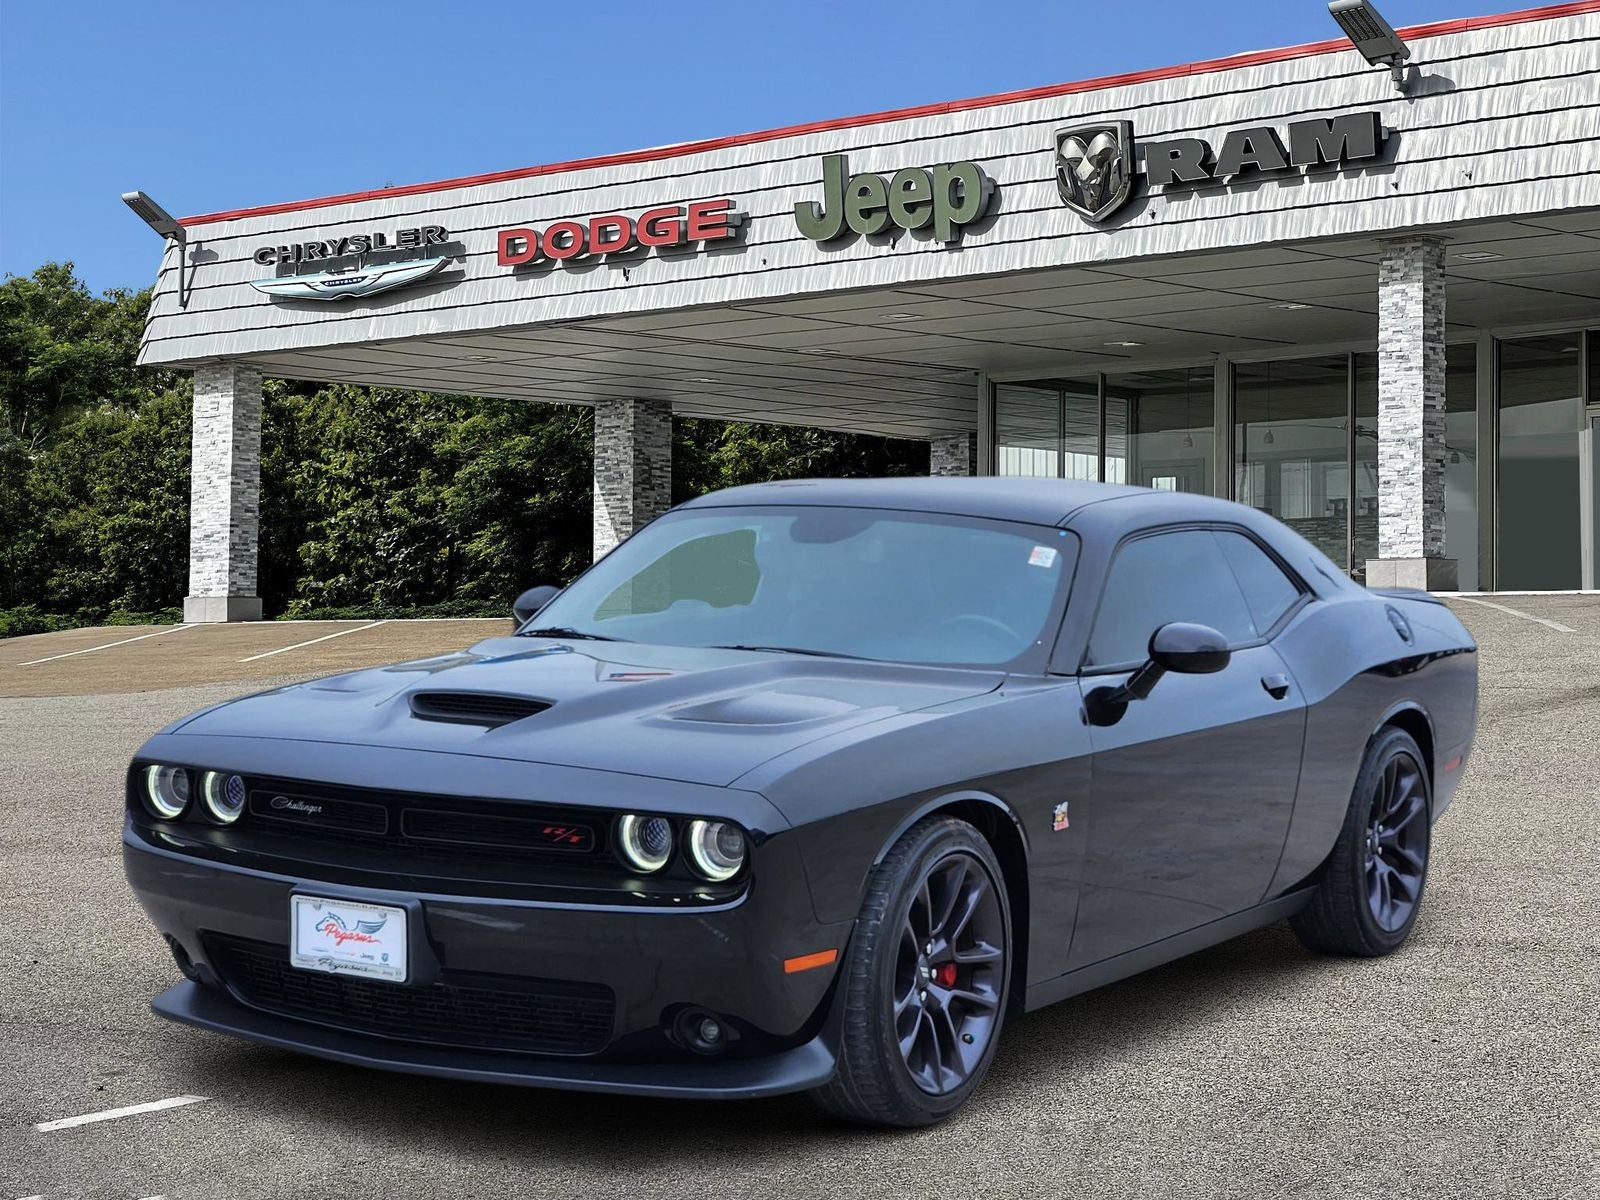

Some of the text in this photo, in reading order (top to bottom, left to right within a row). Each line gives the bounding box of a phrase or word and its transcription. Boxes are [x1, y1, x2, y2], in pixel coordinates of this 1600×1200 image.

[1144, 111, 1381, 186] RAM
[794, 154, 988, 242] Jeep
[253, 225, 449, 266] CHRYSLER
[498, 198, 736, 267] DODGE
[324, 277, 363, 286] CHRYSLER
[270, 796, 322, 815] Challenger
[323, 922, 382, 946] Pegasus
